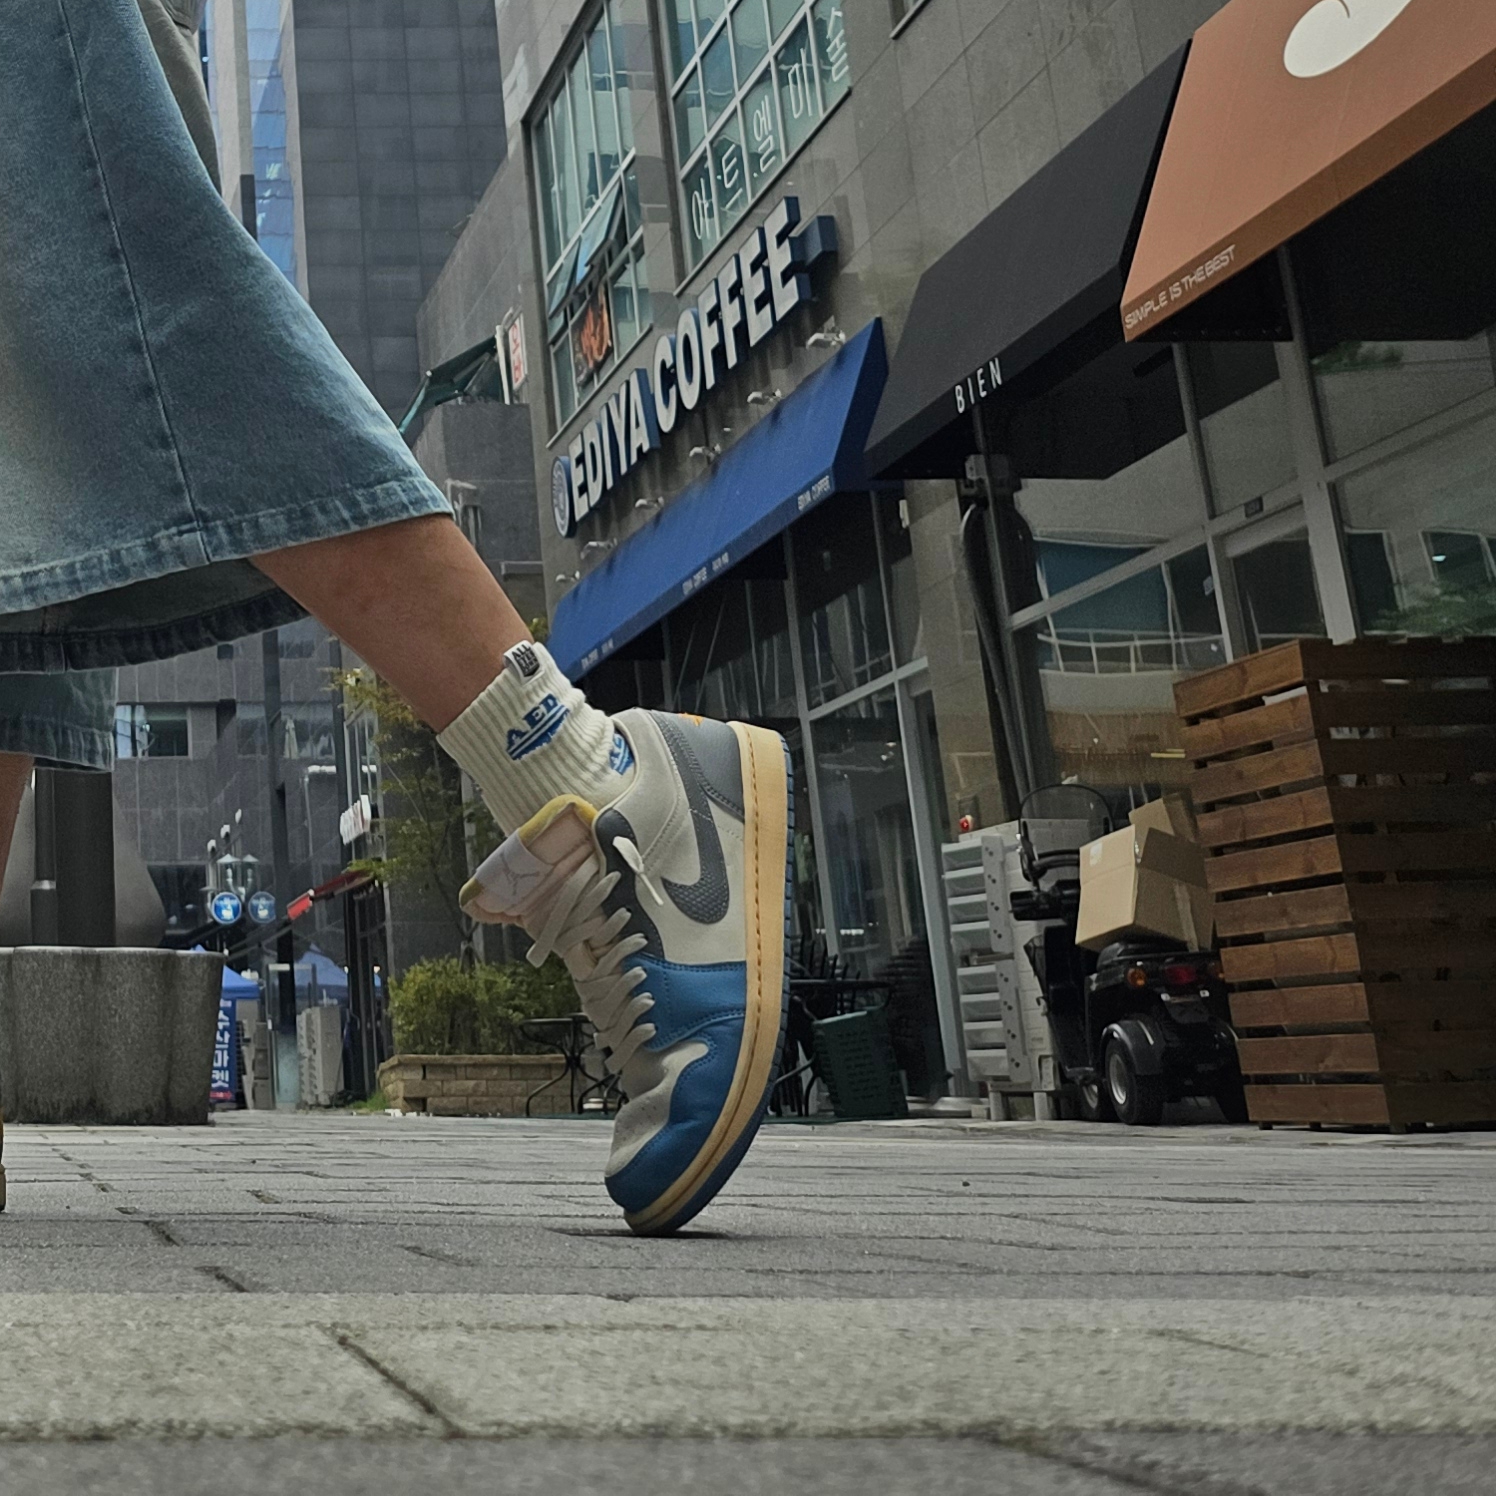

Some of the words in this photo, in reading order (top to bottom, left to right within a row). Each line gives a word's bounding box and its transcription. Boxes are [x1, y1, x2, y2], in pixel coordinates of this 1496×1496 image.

[1124, 290, 1168, 329] SIMPLE
[1169, 282, 1183, 302] IS
[1181, 266, 1206, 292] THE
[1204, 244, 1236, 278] BEST
[568, 369, 654, 523] EDIYA
[654, 197, 802, 434] COFFEE
[955, 357, 1002, 414] BIEN
